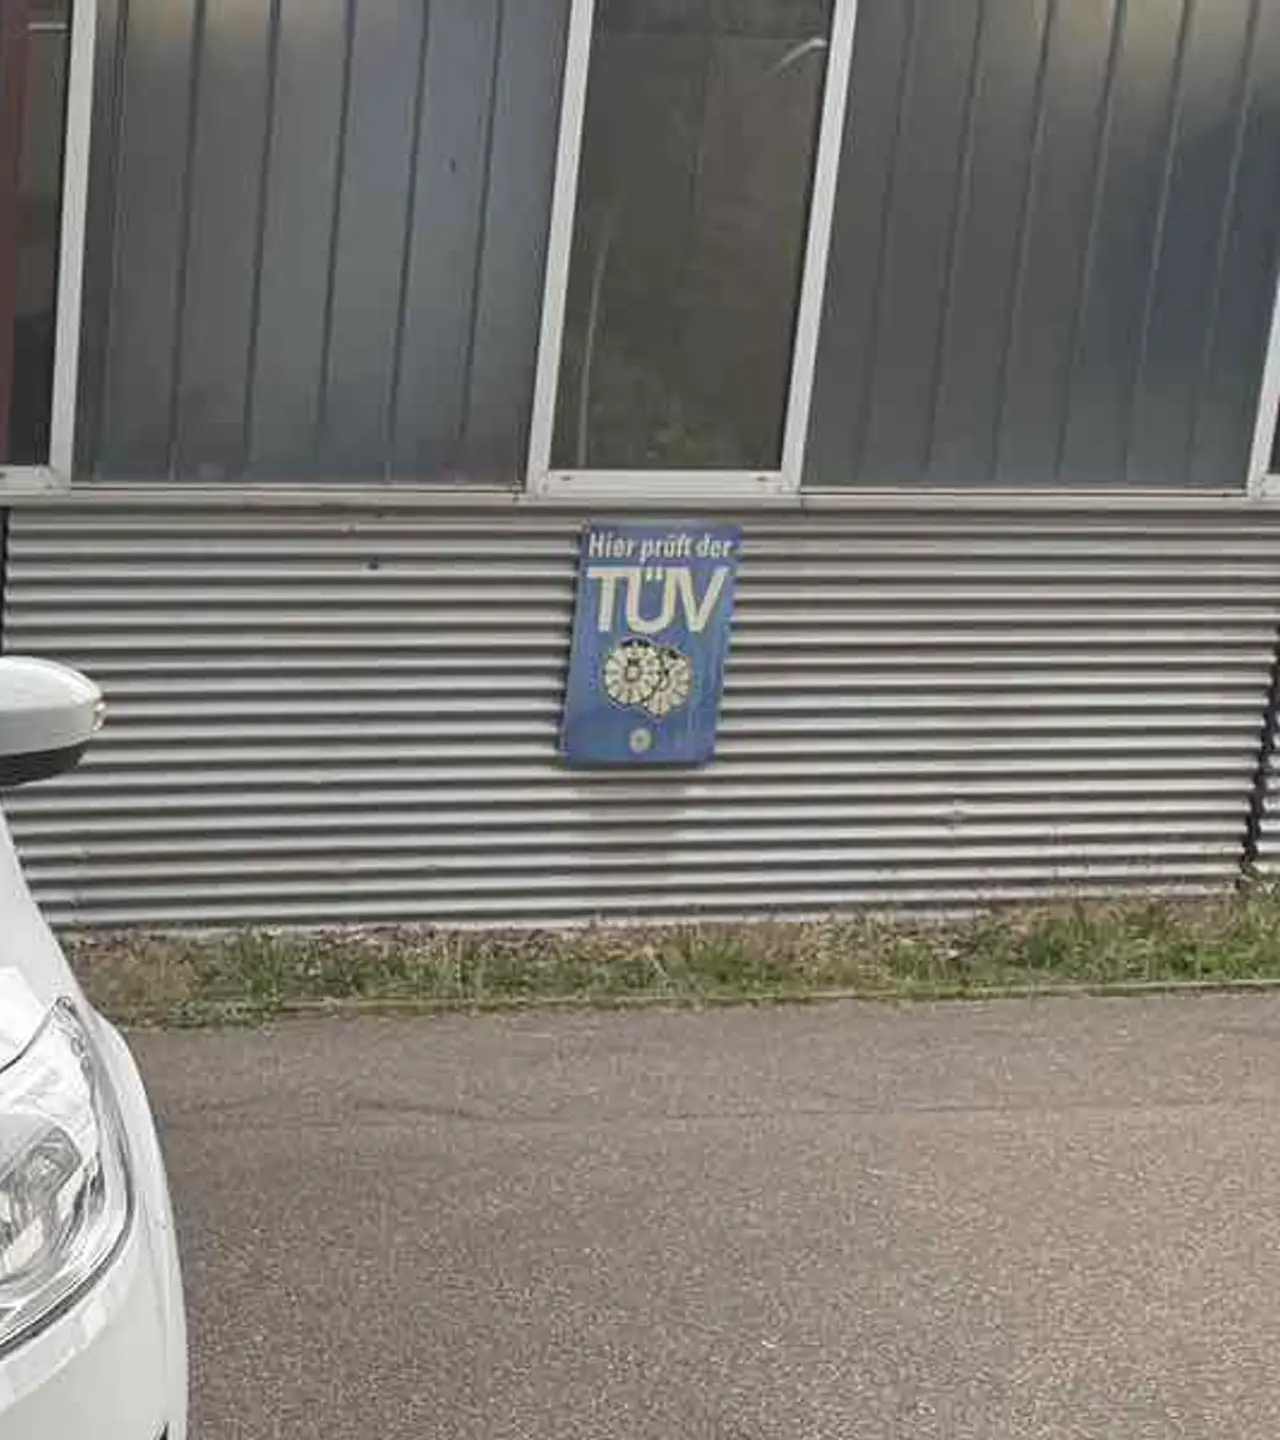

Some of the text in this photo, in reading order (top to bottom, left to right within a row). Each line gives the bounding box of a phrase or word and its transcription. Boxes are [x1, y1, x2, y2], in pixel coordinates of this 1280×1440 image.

[588, 532, 733, 563] Hier prüft der
[587, 564, 729, 634] TÜV
